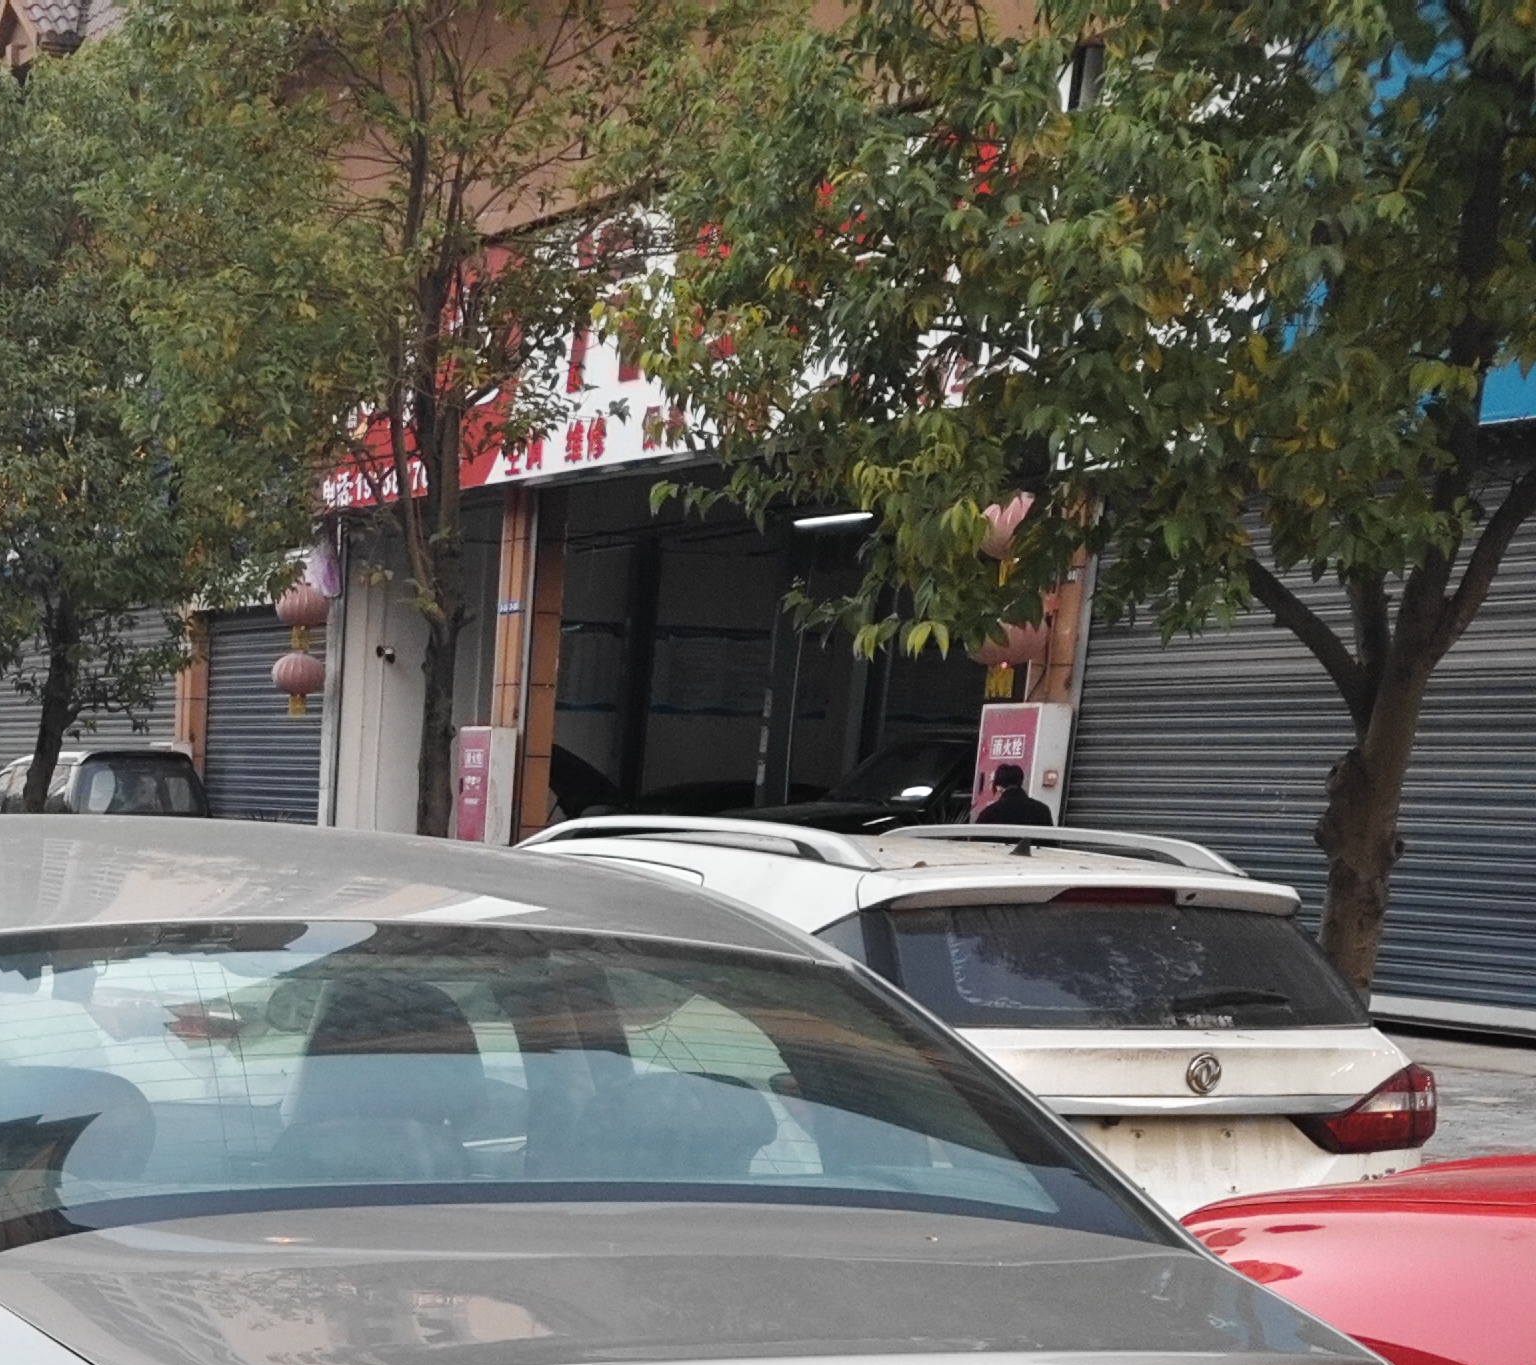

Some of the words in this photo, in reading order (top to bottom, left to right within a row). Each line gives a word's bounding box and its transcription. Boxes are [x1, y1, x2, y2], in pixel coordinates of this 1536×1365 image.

[564, 417, 607, 463] 维修
[992, 738, 1023, 757] 消火栓
